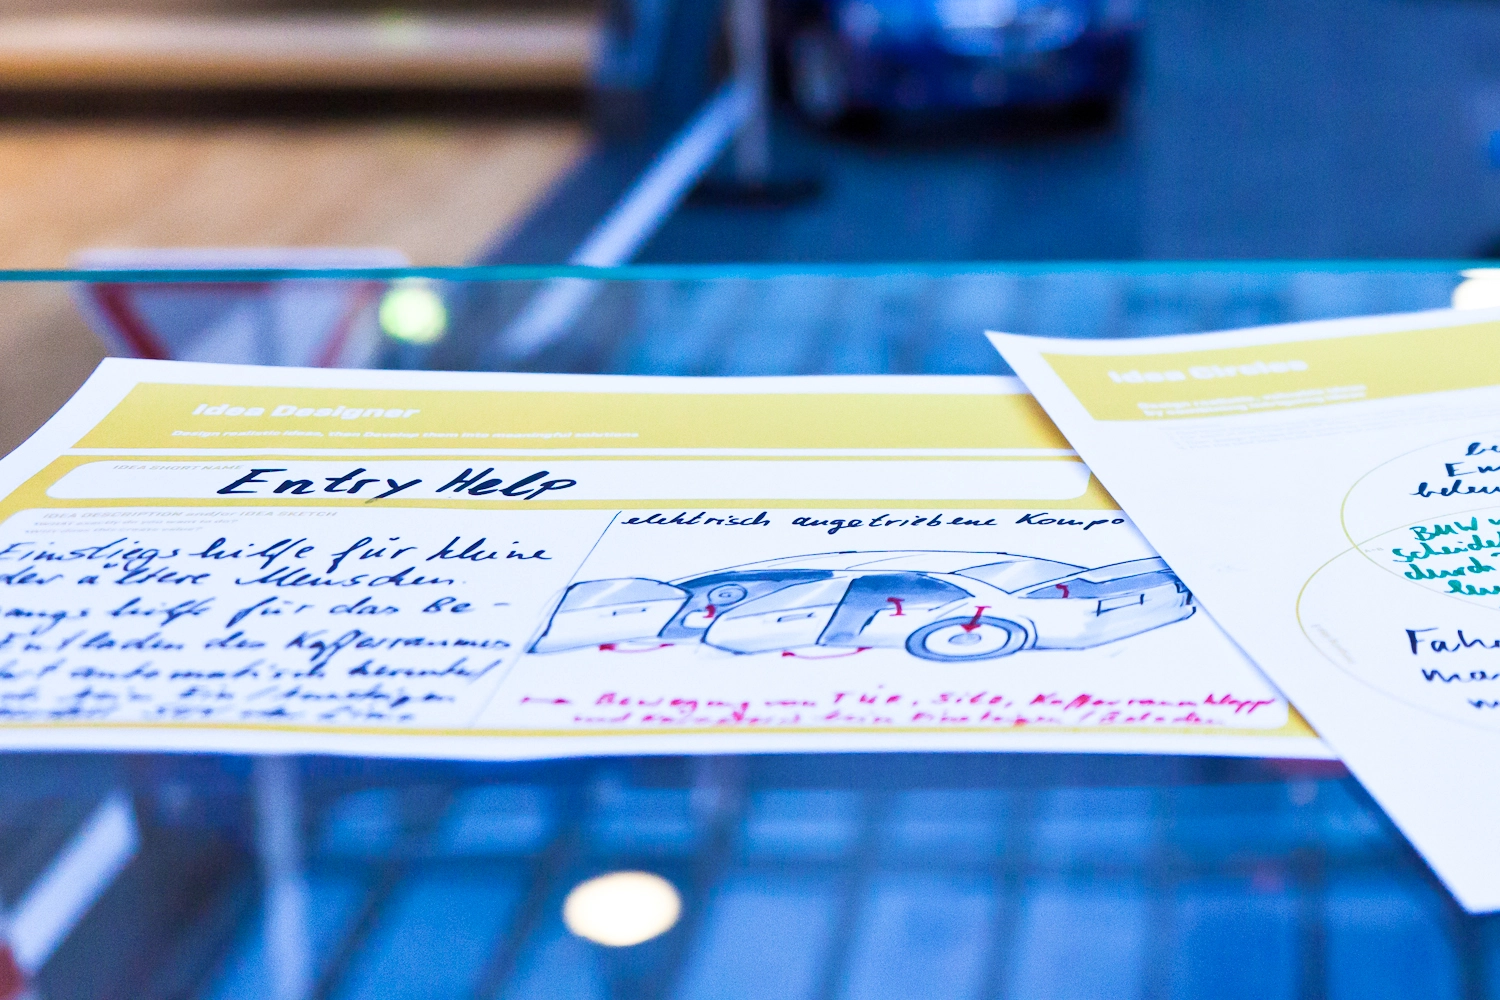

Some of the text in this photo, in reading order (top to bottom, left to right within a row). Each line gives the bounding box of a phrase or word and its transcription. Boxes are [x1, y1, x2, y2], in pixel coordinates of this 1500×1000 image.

[191, 403, 420, 420] Idea Designer
[215, 467, 577, 504] Entry Help
[325, 536, 418, 574] für
